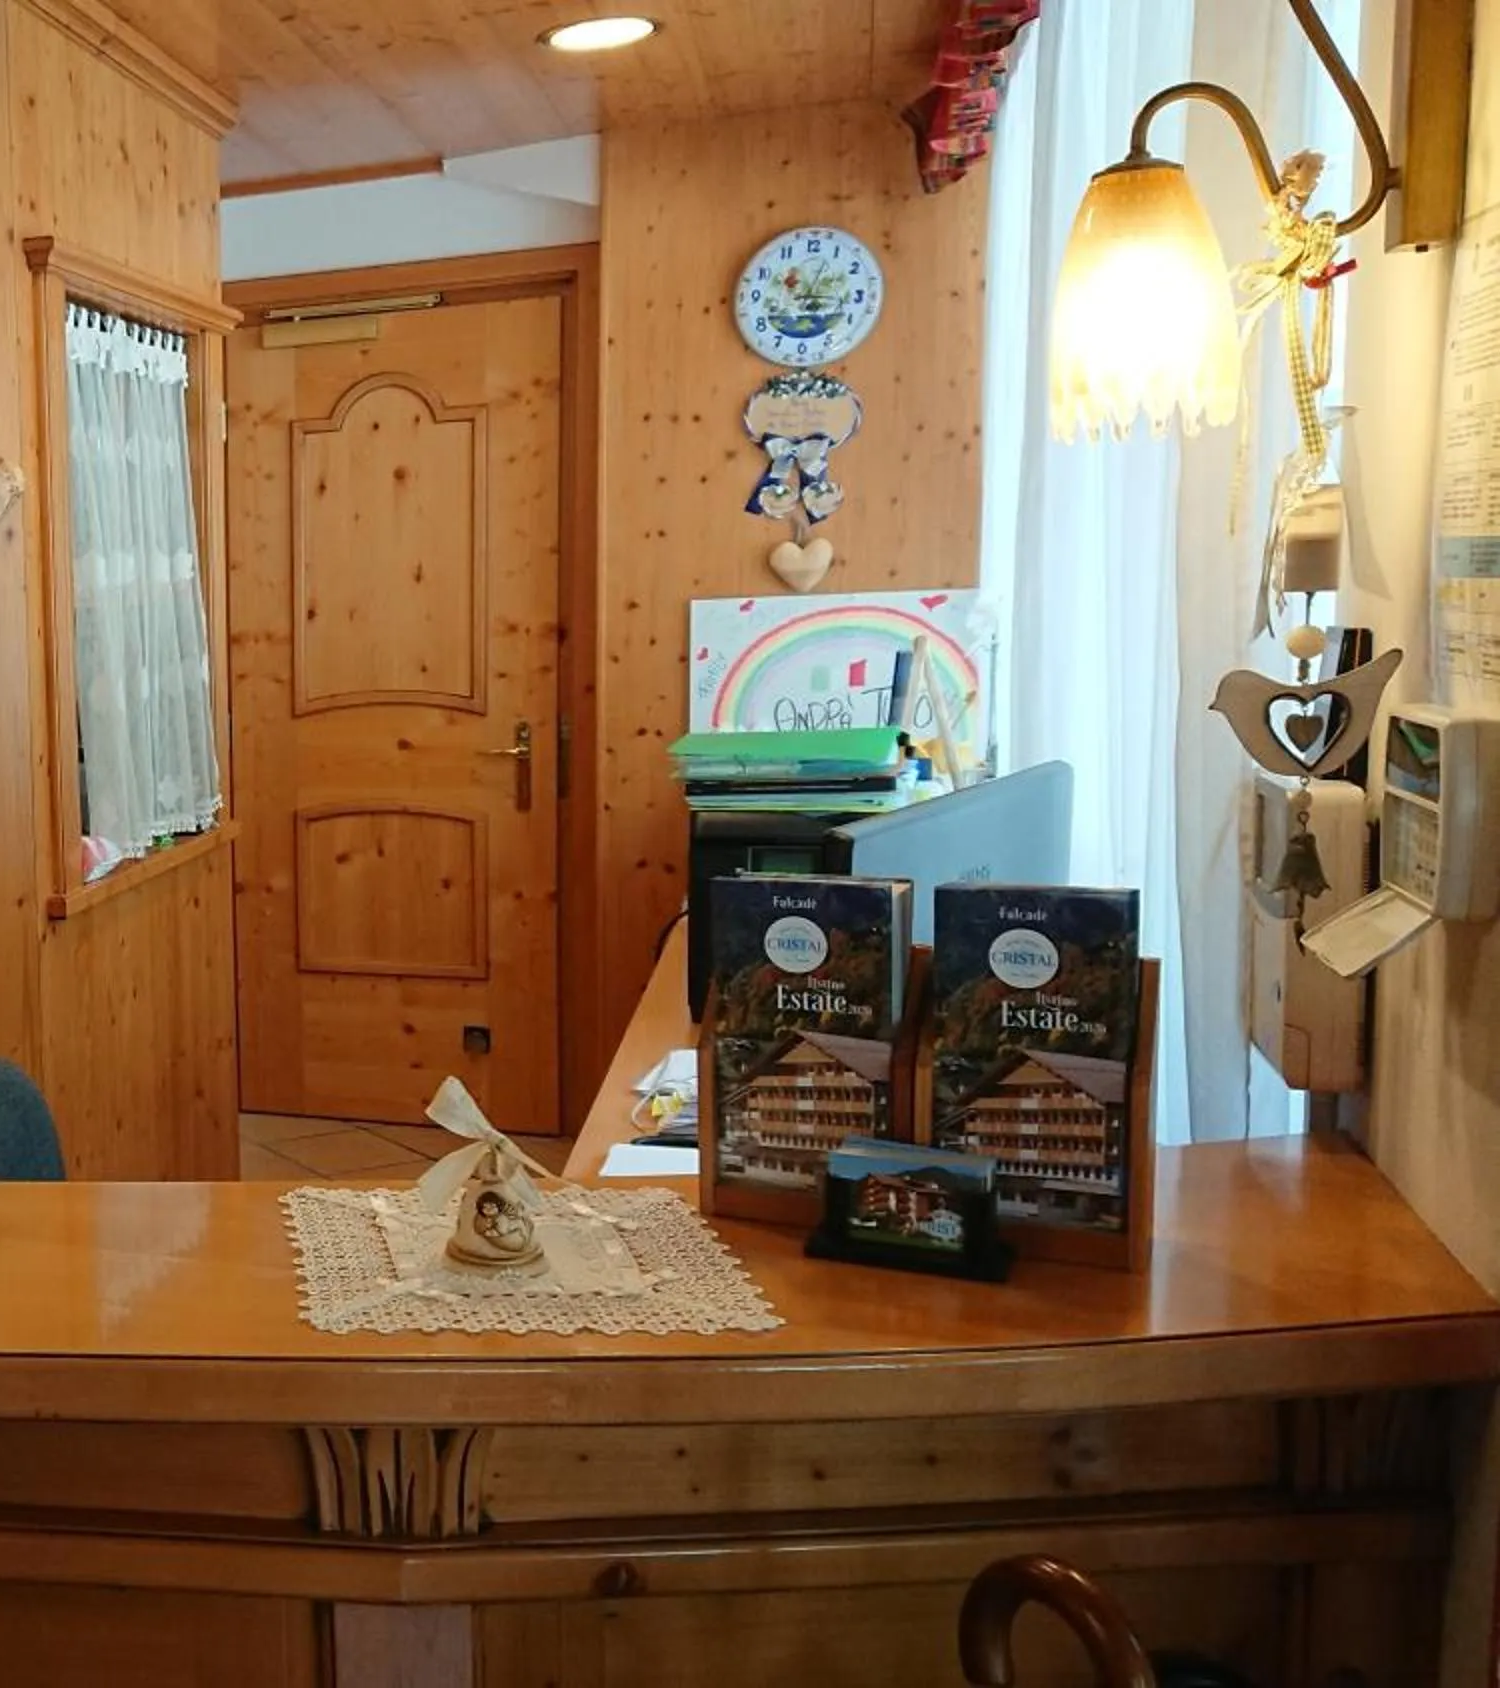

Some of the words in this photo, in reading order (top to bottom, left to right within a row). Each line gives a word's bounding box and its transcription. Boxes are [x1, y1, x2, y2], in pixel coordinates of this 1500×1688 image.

[781, 245, 793, 260] 11
[807, 239, 821, 253] 12
[833, 245, 840, 258] 1
[848, 261, 860, 275] 2
[751, 289, 761, 302] 9
[853, 289, 864, 303] 3
[755, 317, 767, 332] 8
[773, 335, 783, 348] 7
[773, 895, 817, 909] Falcade
[999, 906, 1048, 921] Falcade
[767, 937, 824, 952] CRISTAL
[991, 951, 1056, 967] CRISTAL
[777, 984, 847, 1012] Estate
[1001, 1000, 1079, 1031] Estate
